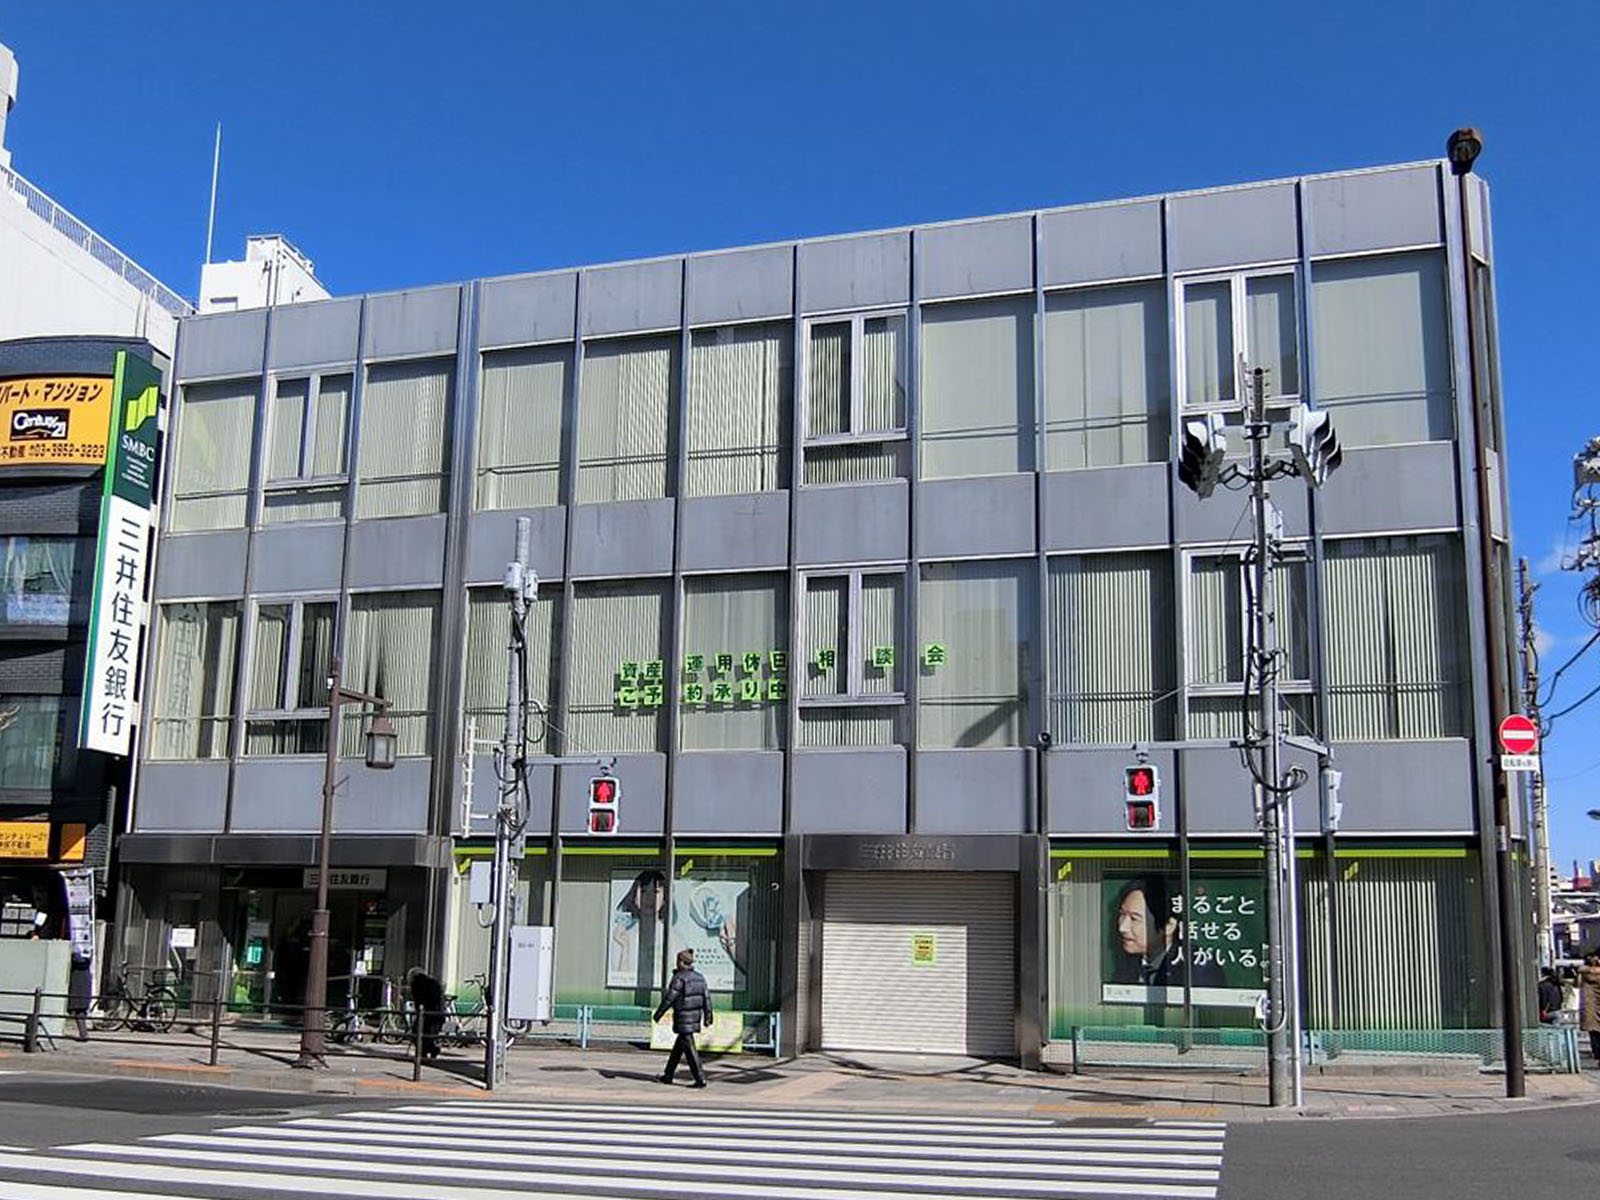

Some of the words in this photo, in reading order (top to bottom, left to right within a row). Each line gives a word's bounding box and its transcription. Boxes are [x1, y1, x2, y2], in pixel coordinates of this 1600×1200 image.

[0, 383, 102, 404] パート・マンション
[122, 434, 155, 462] SMBC
[102, 517, 141, 736] 三井住友銀行
[310, 873, 370, 886] 三住友銀行
[1170, 895, 1255, 914] まるごと
